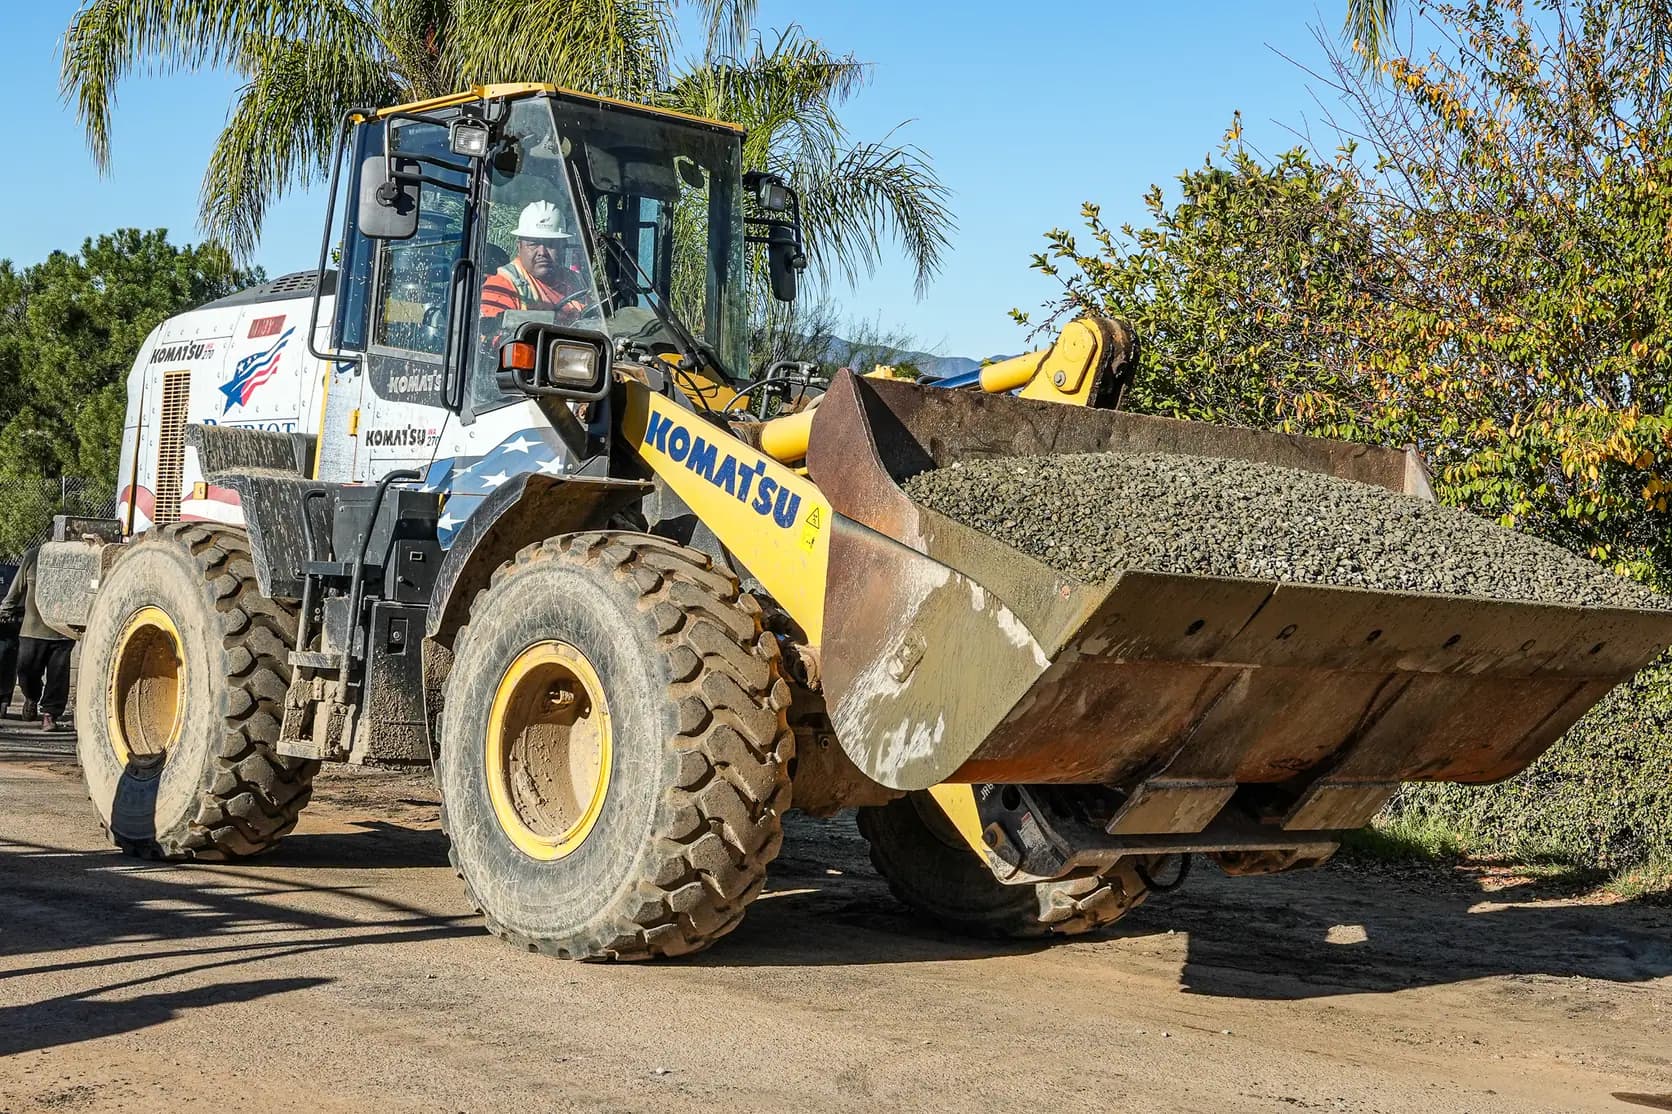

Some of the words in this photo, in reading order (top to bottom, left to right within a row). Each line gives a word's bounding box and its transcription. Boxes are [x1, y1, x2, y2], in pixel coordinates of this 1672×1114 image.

[150, 340, 205, 364] KOMATSU
[365, 424, 426, 446] KOMATSU
[644, 410, 802, 529] KOMATSU
